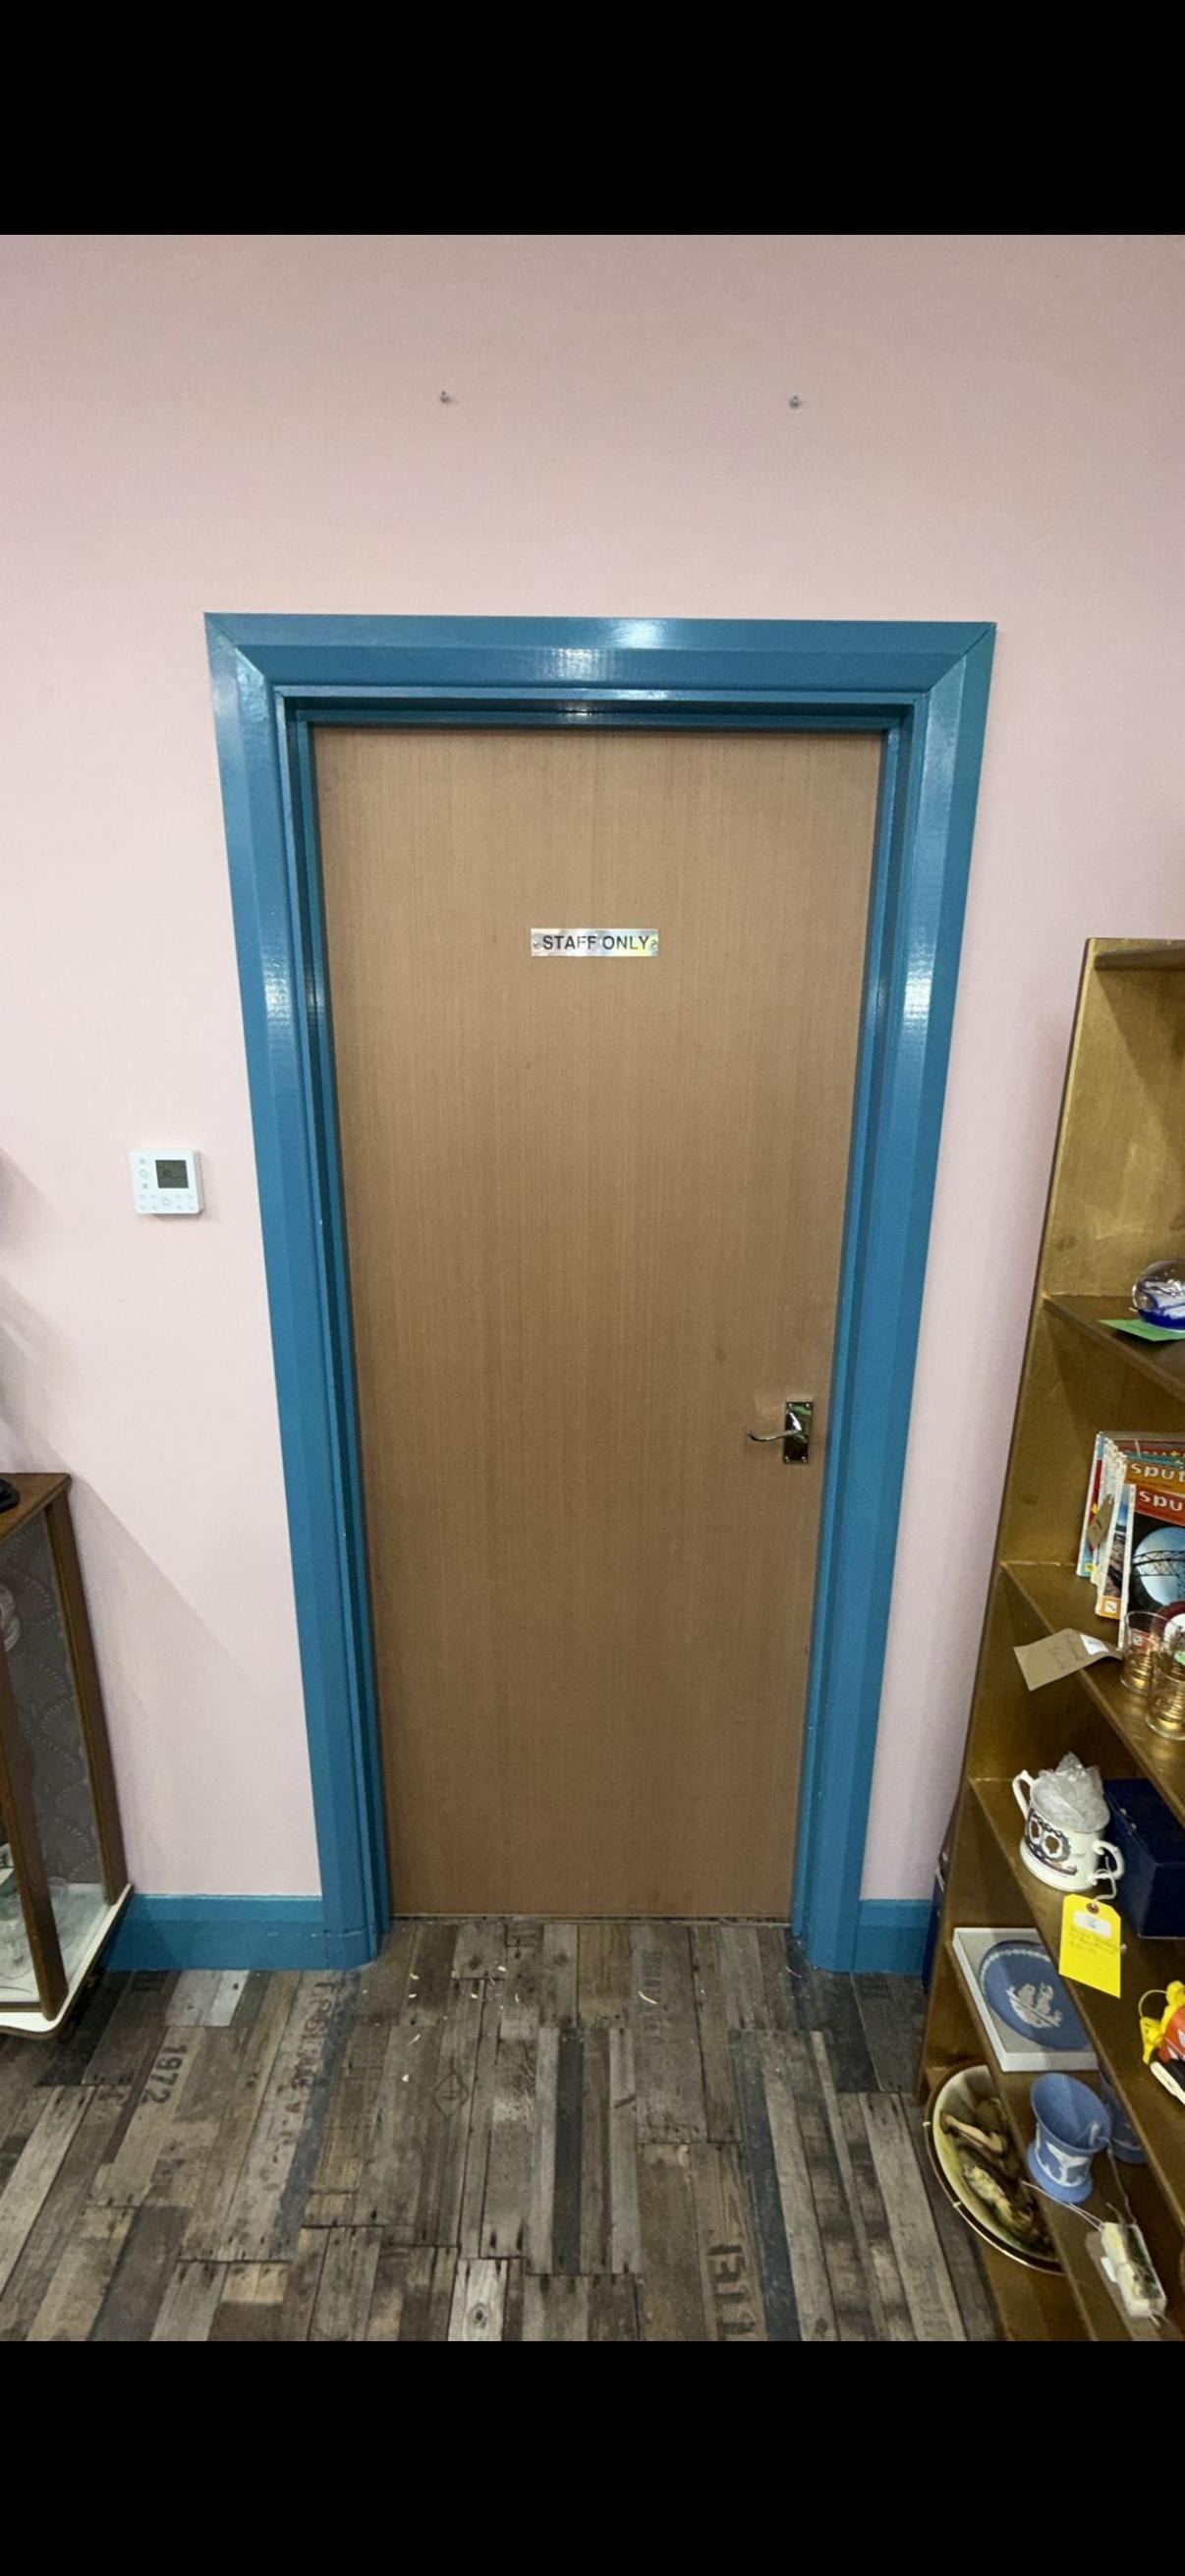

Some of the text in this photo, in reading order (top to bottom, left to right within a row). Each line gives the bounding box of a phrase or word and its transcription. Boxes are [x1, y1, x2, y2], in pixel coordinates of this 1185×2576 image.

[542, 935, 649, 950] STAFF ONLY
[1139, 1490, 1183, 1511] spu
[142, 2044, 187, 2104] 1972
